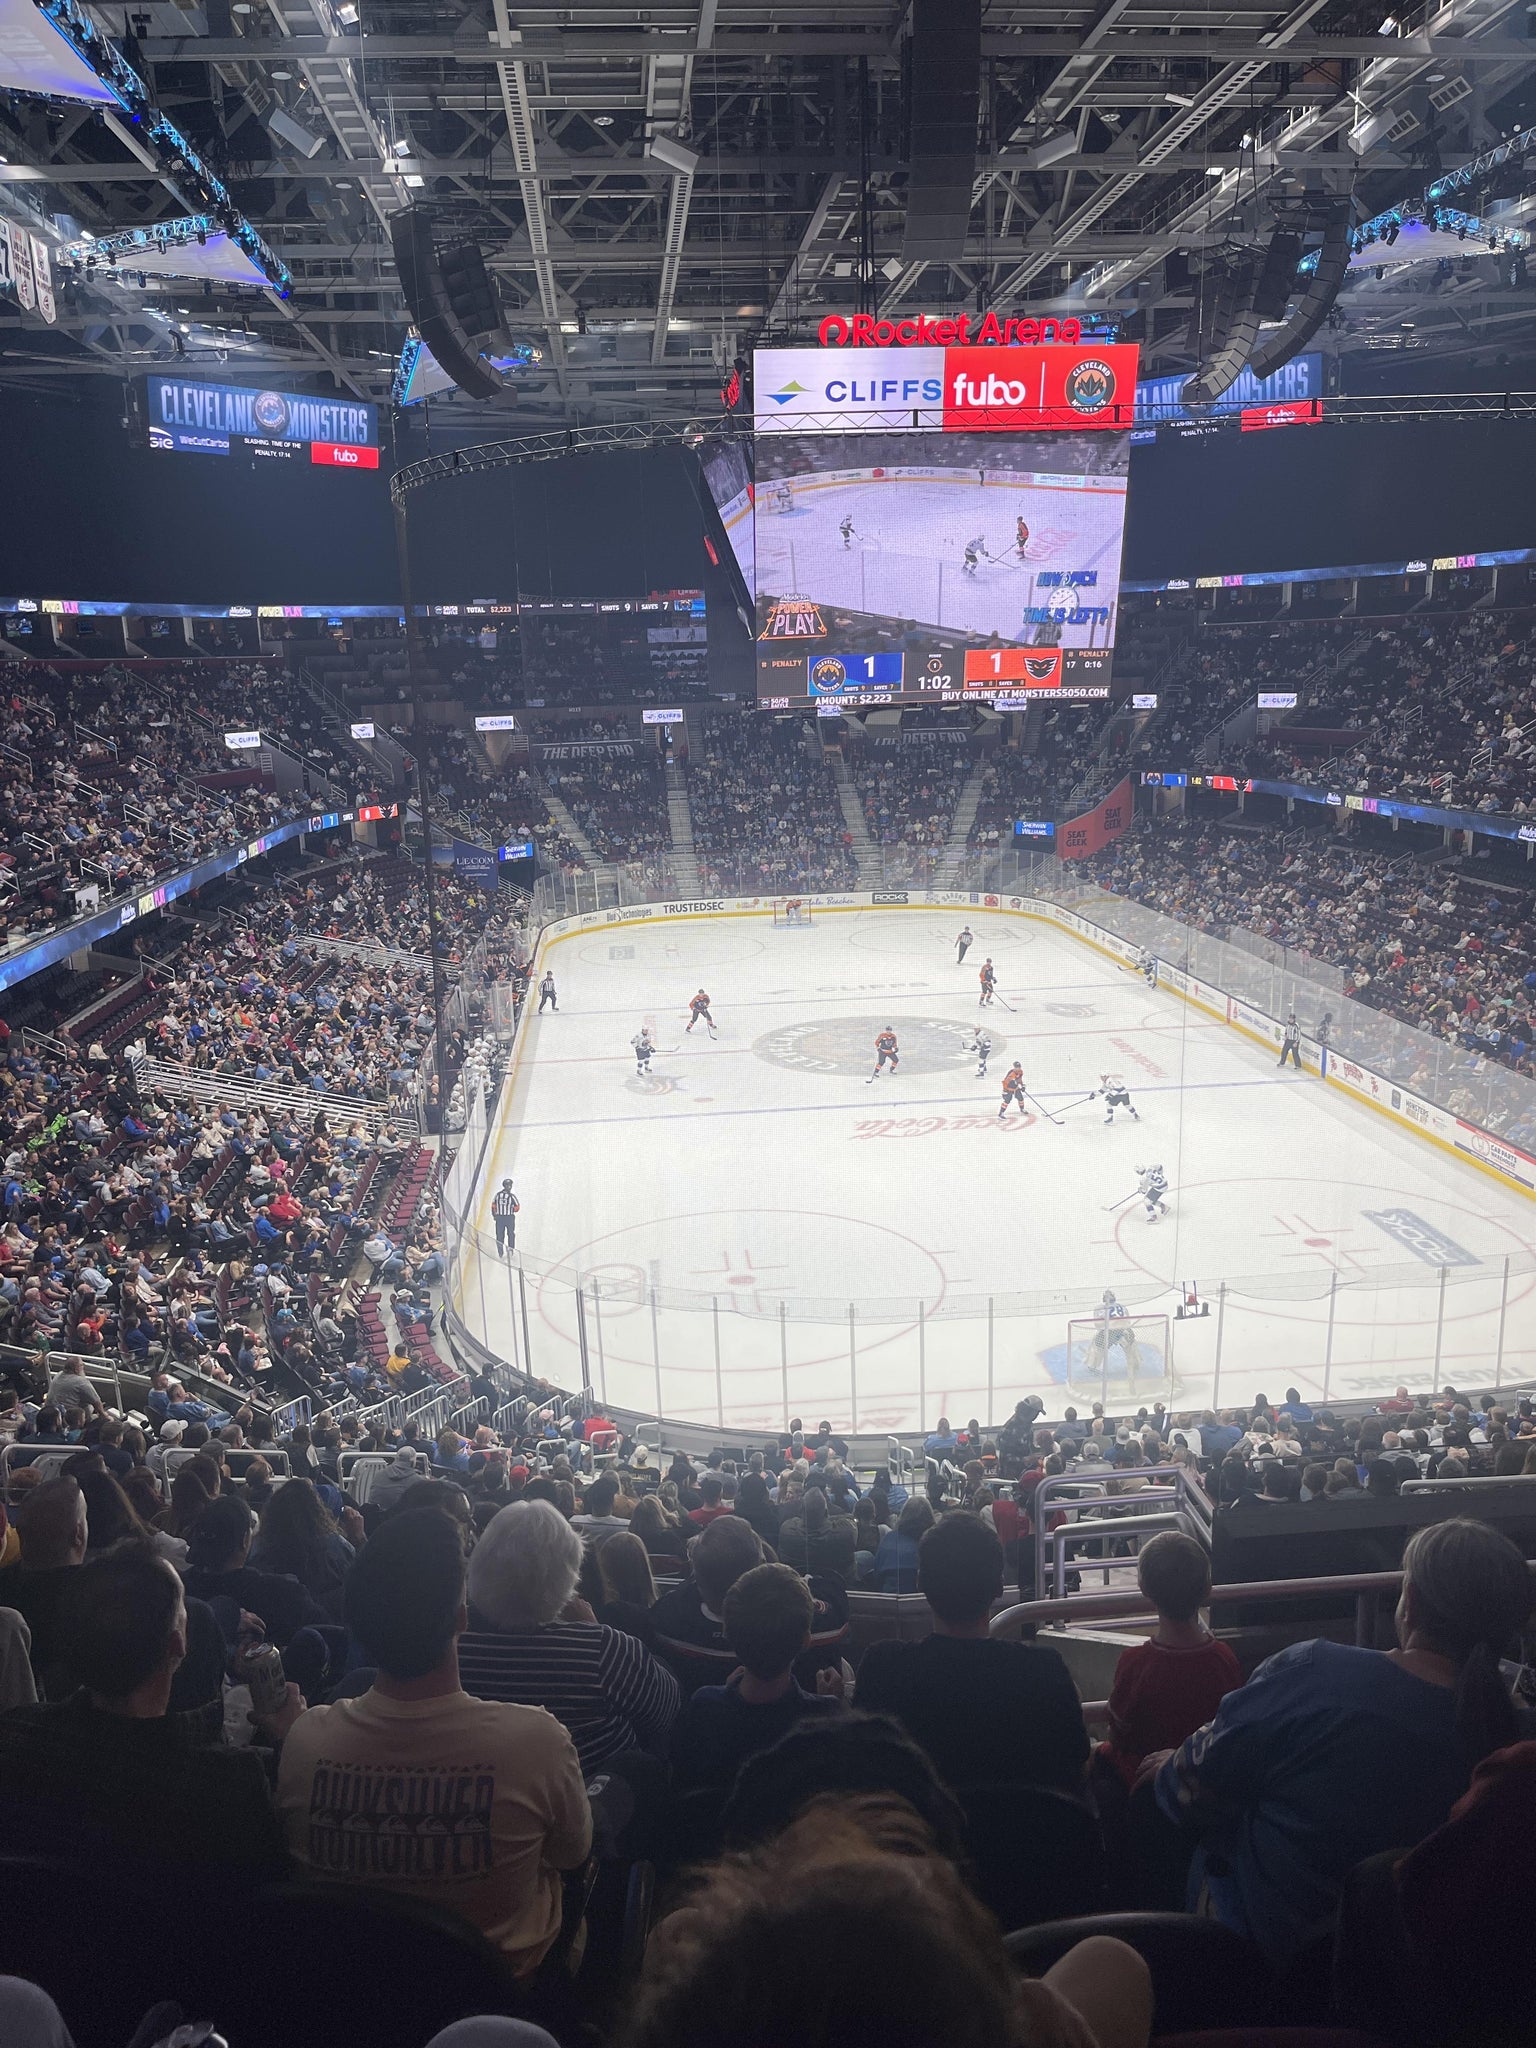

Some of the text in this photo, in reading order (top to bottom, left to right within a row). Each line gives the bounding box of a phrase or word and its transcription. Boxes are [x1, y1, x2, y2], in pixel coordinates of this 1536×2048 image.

[853, 312, 1081, 345] Rocket Arena
[1072, 362, 1110, 376] CLEVELAND
[826, 380, 942, 402] CLIFFS
[953, 373, 1026, 406] fubo
[160, 384, 368, 444] CLEVELAND MONSTERS
[333, 449, 358, 463] fubo
[1458, 554, 1476, 568] PLAY
[1224, 575, 1242, 586] PLAY
[284, 606, 302, 617] PLAY
[624, 603, 630, 611] 9
[662, 602, 669, 610] 7
[777, 602, 812, 614] POWER
[1023, 607, 1108, 626] TIME IS LEFT?
[772, 614, 815, 636] PLAY
[772, 660, 802, 668] PENALTY
[816, 660, 842, 670] CLEVELAND
[864, 656, 875, 678] 1
[990, 652, 1001, 673] 1
[918, 676, 951, 690] 1:02
[815, 694, 892, 705] AMOUNT: $2,223
[942, 688, 1108, 700] BUY ONLINE AT MONSTERS5050.COM
[542, 748, 568, 760] THE
[571, 746, 605, 758] DEEP
[1105, 807, 1122, 819] SEAT
[1104, 818, 1122, 831] GEEK
[1068, 831, 1087, 839] SEAT
[1066, 838, 1087, 847] GEEK
[664, 902, 724, 914] TRUSTEDSEC
[1501, 1148, 1517, 1164] PARTS
[1109, 1304, 1123, 1318] 28
[310, 1768, 494, 1818] QUIKSILVER
